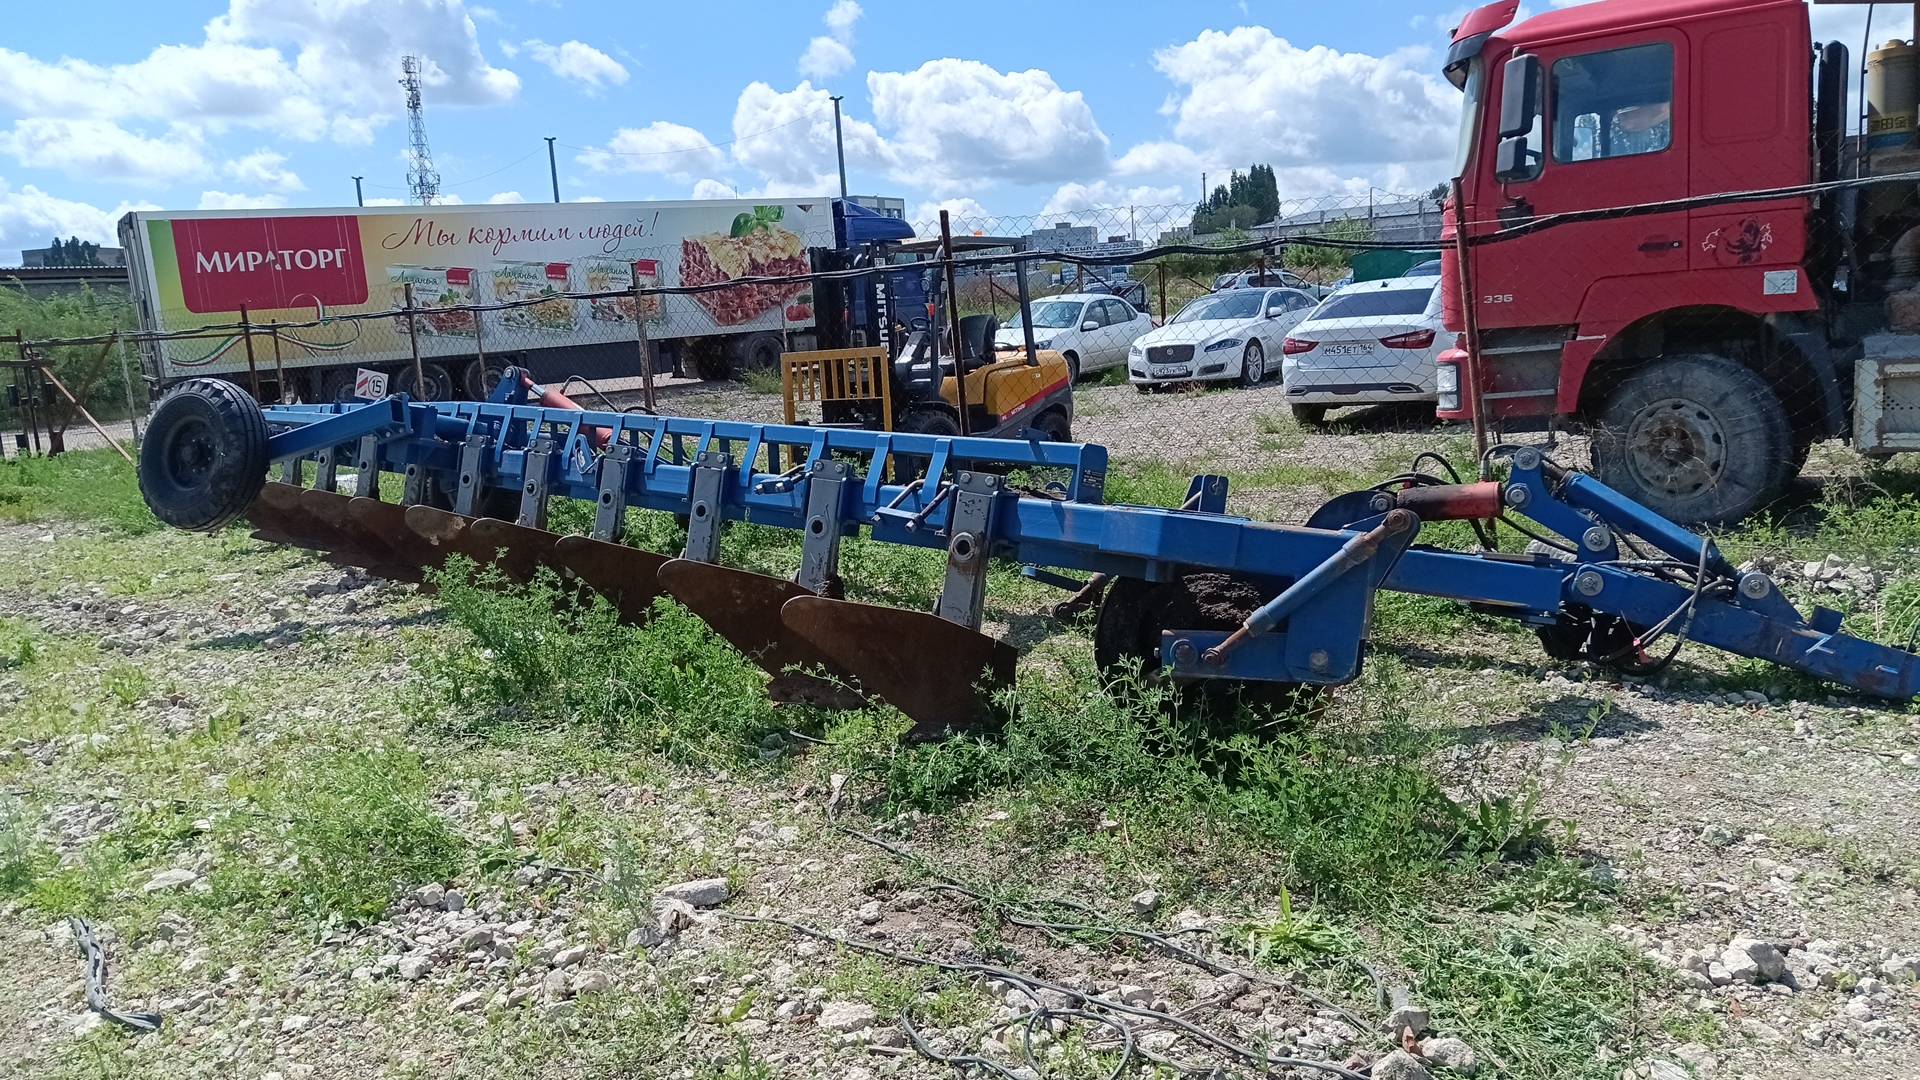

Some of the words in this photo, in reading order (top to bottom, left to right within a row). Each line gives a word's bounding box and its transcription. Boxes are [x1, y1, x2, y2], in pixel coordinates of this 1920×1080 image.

[382, 219, 461, 250] Мы
[468, 223, 575, 256] кормим
[579, 212, 659, 254] людей!
[197, 249, 346, 274] МИРАТОРГ
[1484, 294, 1513, 304] 336
[372, 379, 382, 394] 15
